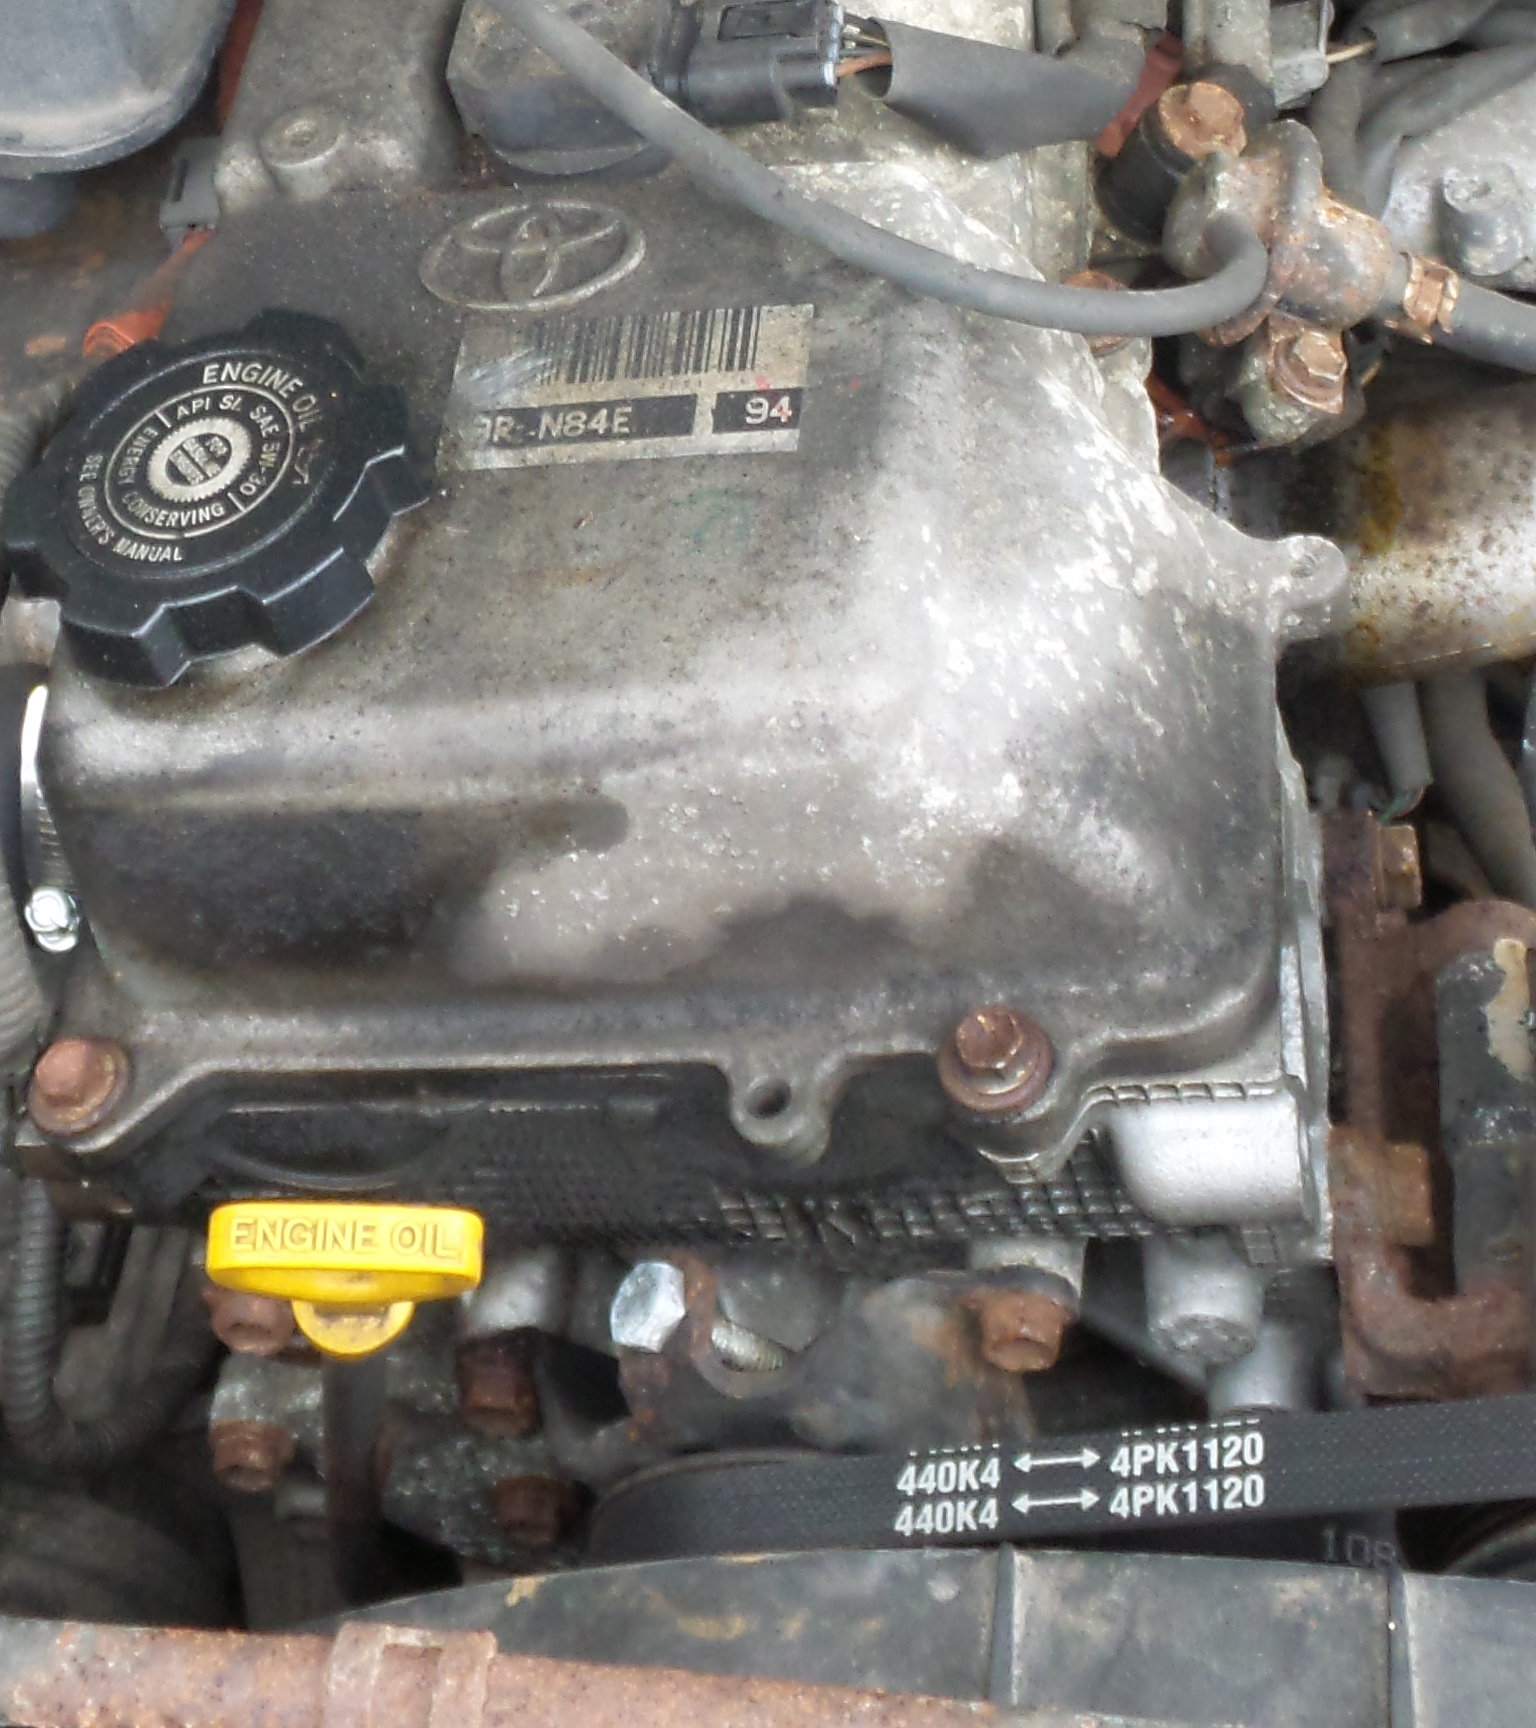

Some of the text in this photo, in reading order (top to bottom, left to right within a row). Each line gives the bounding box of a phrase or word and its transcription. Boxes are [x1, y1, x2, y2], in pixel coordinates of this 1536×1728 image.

[203, 361, 304, 399] ENGINE
[176, 396, 211, 420] API
[249, 405, 280, 438] SAE
[745, 395, 792, 425] 94
[118, 426, 159, 485] ENERGY
[121, 490, 225, 528] CONSERVING
[111, 537, 183, 563] MANUAL
[230, 1217, 461, 1260] ENGINE OIL
[897, 1431, 1264, 1497] 440K4 4PK1120
[893, 1472, 1264, 1537] 440K4 4PK1120
